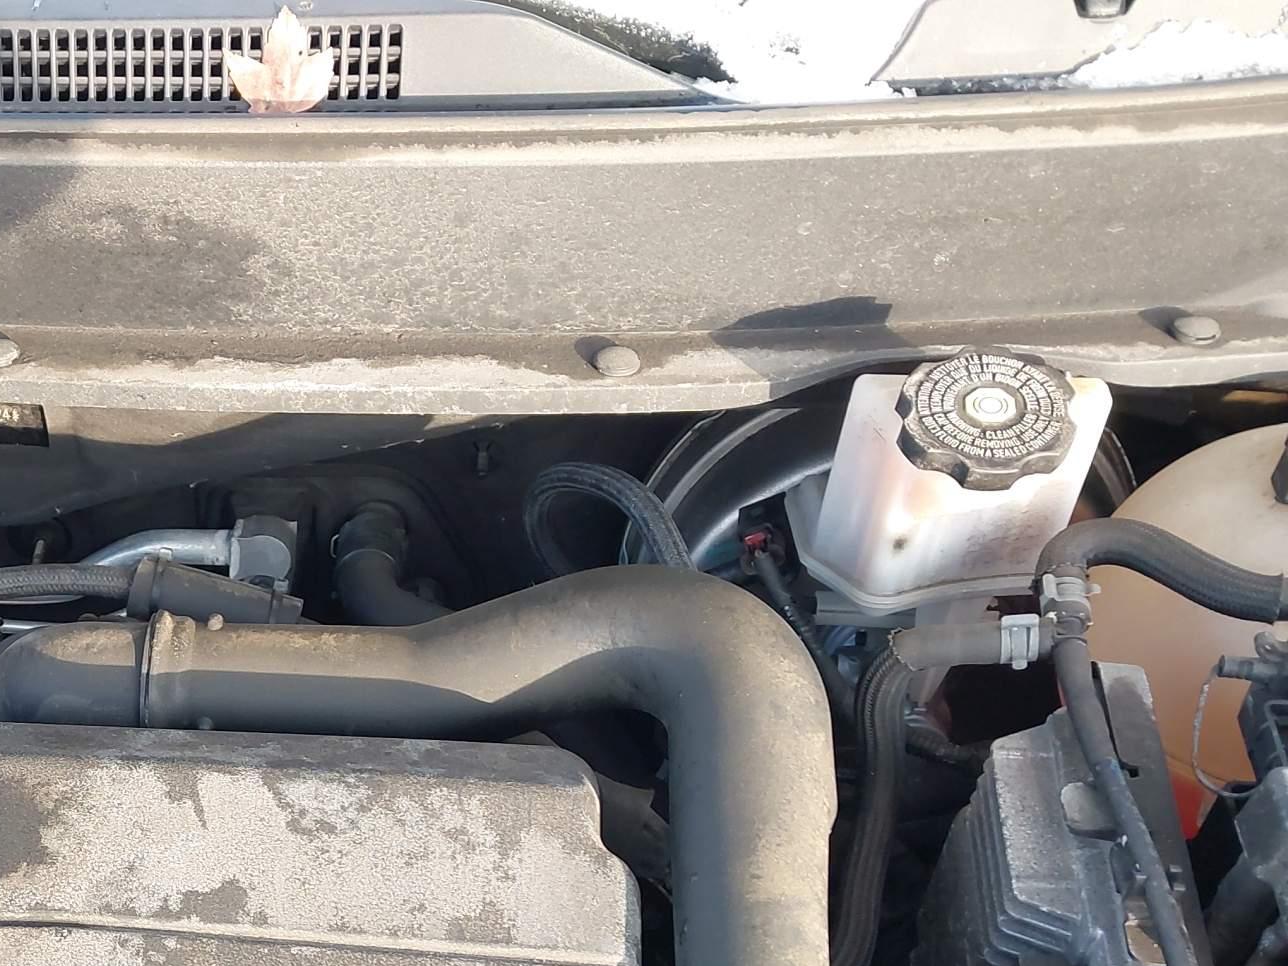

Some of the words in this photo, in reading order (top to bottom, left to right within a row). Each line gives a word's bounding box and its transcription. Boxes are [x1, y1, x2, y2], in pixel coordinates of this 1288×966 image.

[968, 364, 982, 373] DU
[1015, 371, 1032, 383] DE
[982, 355, 1024, 370] BOUCHON
[933, 413, 950, 427] CAP
[942, 423, 975, 445] BEFORE
[1020, 428, 1039, 443] USE
[1032, 416, 1051, 433] ONLY
[935, 430, 960, 448] FLUID
[958, 442, 985, 457] FROM
[985, 448, 992, 457] A
[992, 445, 1028, 458] SEALED
[1025, 420, 1061, 452] CONTAINER
[986, 428, 1017, 440] CLEAN
[1012, 413, 1038, 434] FILLER
